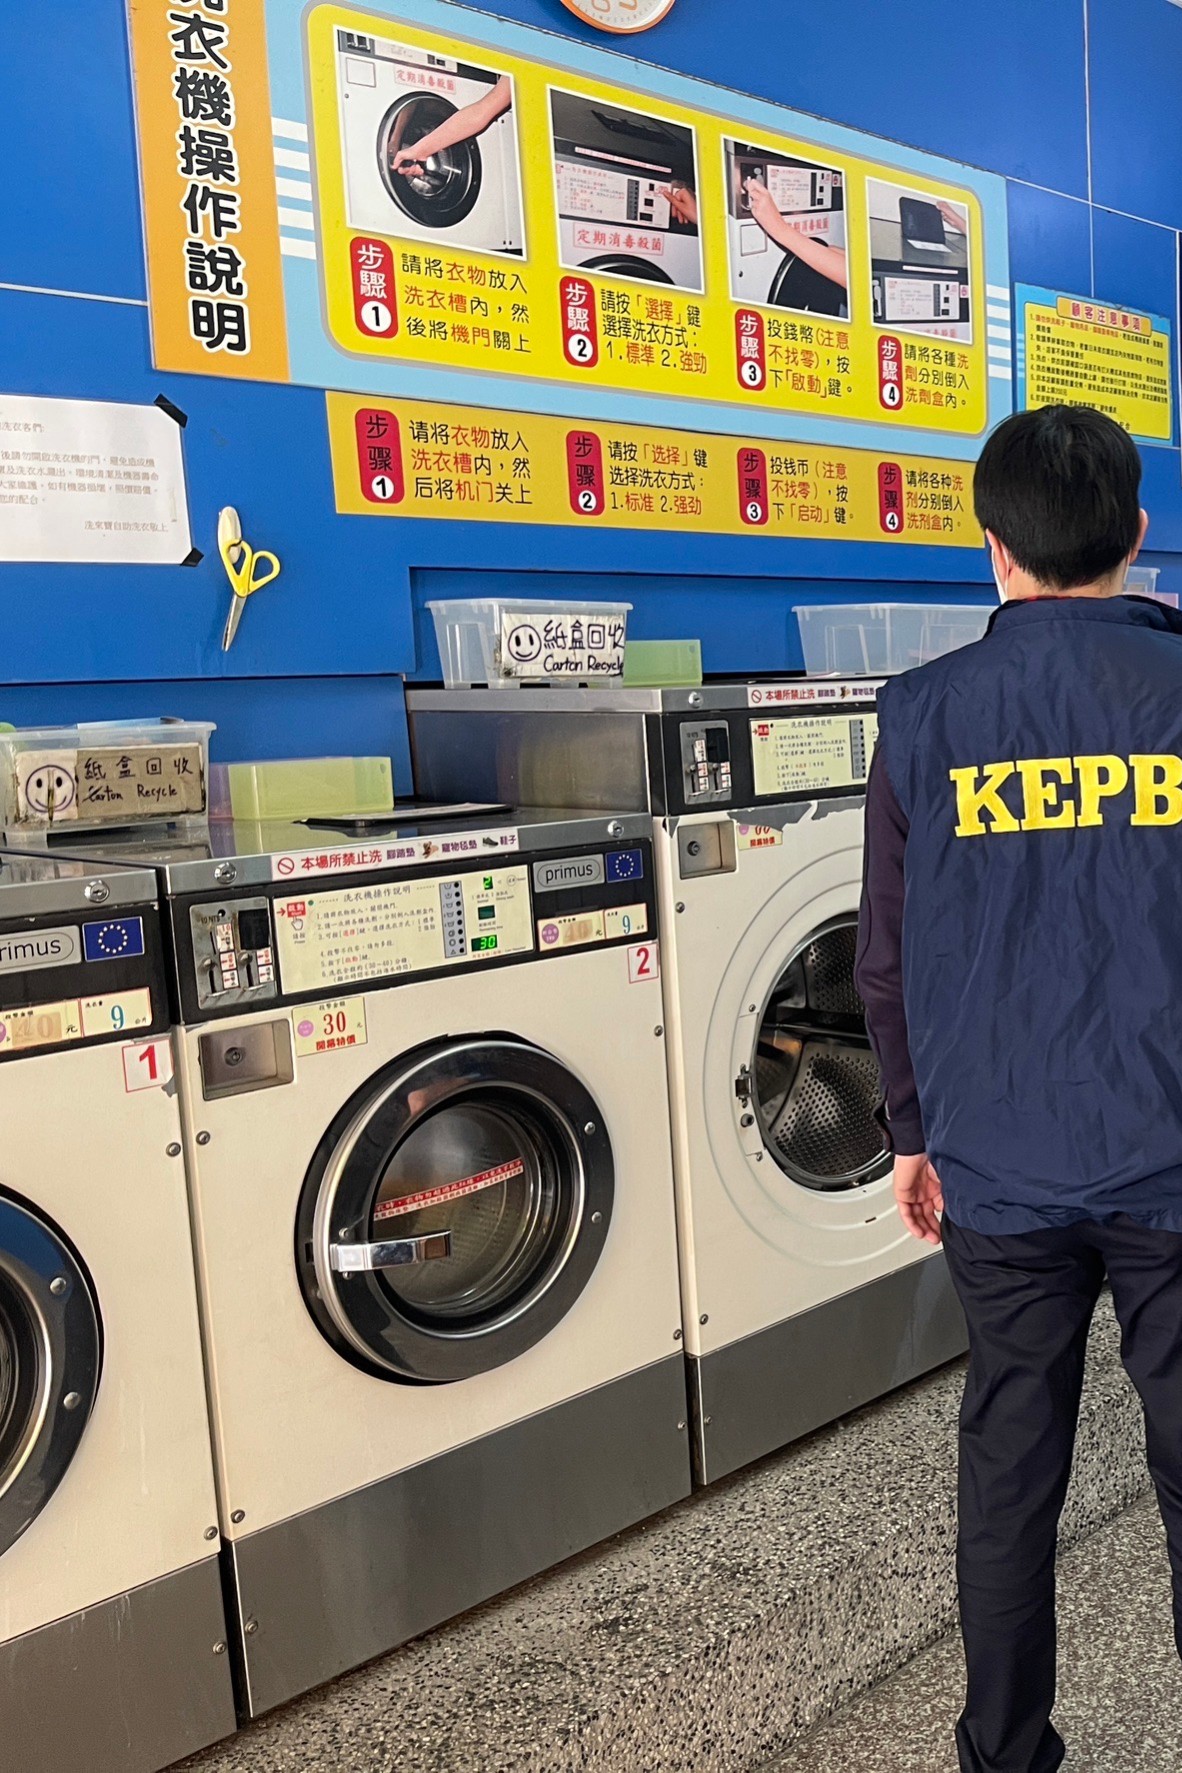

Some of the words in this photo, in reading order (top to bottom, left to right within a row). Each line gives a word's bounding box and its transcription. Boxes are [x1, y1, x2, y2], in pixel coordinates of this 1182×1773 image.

[166, 0, 250, 353] 衣機操作說明
[577, 228, 663, 252] 定期消毒殺菌
[357, 243, 388, 300] 步驟
[401, 252, 527, 295] 請將衣物放入
[371, 305, 381, 327] 1
[404, 284, 530, 324] 洗衣槽內，然
[565, 282, 590, 332] 步驟
[600, 288, 701, 328] 請按「選擇」鍵
[1071, 301, 1142, 332] 顧客注意事項
[406, 316, 532, 354] 後將機門關上
[602, 314, 698, 349] 選擇洗衣方式：
[739, 314, 760, 359] 步驟
[767, 318, 850, 350] 投錢幣(注意
[577, 339, 588, 357] 2
[606, 341, 655, 365] 1.標準
[661, 349, 707, 374] 2.強勁
[768, 344, 850, 375] 不找零)，按
[881, 340, 899, 381] 步驟
[904, 343, 969, 369] 請將各種洗
[748, 364, 757, 382] 3
[770, 368, 853, 399] 下「啟動」鍵。
[904, 365, 970, 391] 劑分別倒入
[889, 386, 896, 403] 4
[905, 386, 968, 409] 洗劑盒內。
[0, 421, 45, 434] 洗衣客們:
[408, 419, 529, 453] 请将衣物放入
[365, 413, 393, 471] 步骤
[607, 440, 708, 468] 请按「选择」键
[411, 447, 532, 480] 洗衣槽内，然
[574, 435, 596, 487] 步骤
[375, 477, 387, 497] 1
[609, 465, 705, 491] 选择洗衣方式：
[743, 453, 762, 499] 步骤
[883, 467, 898, 510] 步骤
[905, 469, 964, 492] 请将各种洗
[413, 476, 533, 506] 后将机门关上
[581, 492, 593, 510] 2
[611, 492, 655, 513] 1.标准
[660, 494, 702, 516] 2.强劲
[905, 491, 965, 513] 剂分别倒入
[750, 504, 758, 519] 3
[772, 503, 855, 525] 下「启动」键。
[888, 514, 896, 528] 4
[906, 511, 963, 532] 洗剂盒内。
[543, 619, 625, 650] 紙盒回收
[543, 655, 583, 673] Carton
[765, 689, 816, 702] 本場所禁止洗
[84, 755, 194, 781] 紙盒回收
[137, 783, 178, 802] Recycle
[300, 849, 383, 871] 本場所禁止洗
[499, 834, 517, 846] 鞋子
[545, 864, 594, 885] primus
[343, 886, 411, 902] 洗衣機操作說明
[622, 914, 631, 935] 9
[0, 940, 61, 962] rimus
[480, 936, 497, 950] 30
[637, 947, 650, 976] 2
[65, 1023, 78, 1034] 元
[110, 1004, 125, 1031] 9
[323, 1010, 347, 1035] 30
[315, 1034, 356, 1051] 開幕特價
[139, 1045, 157, 1080] 1
